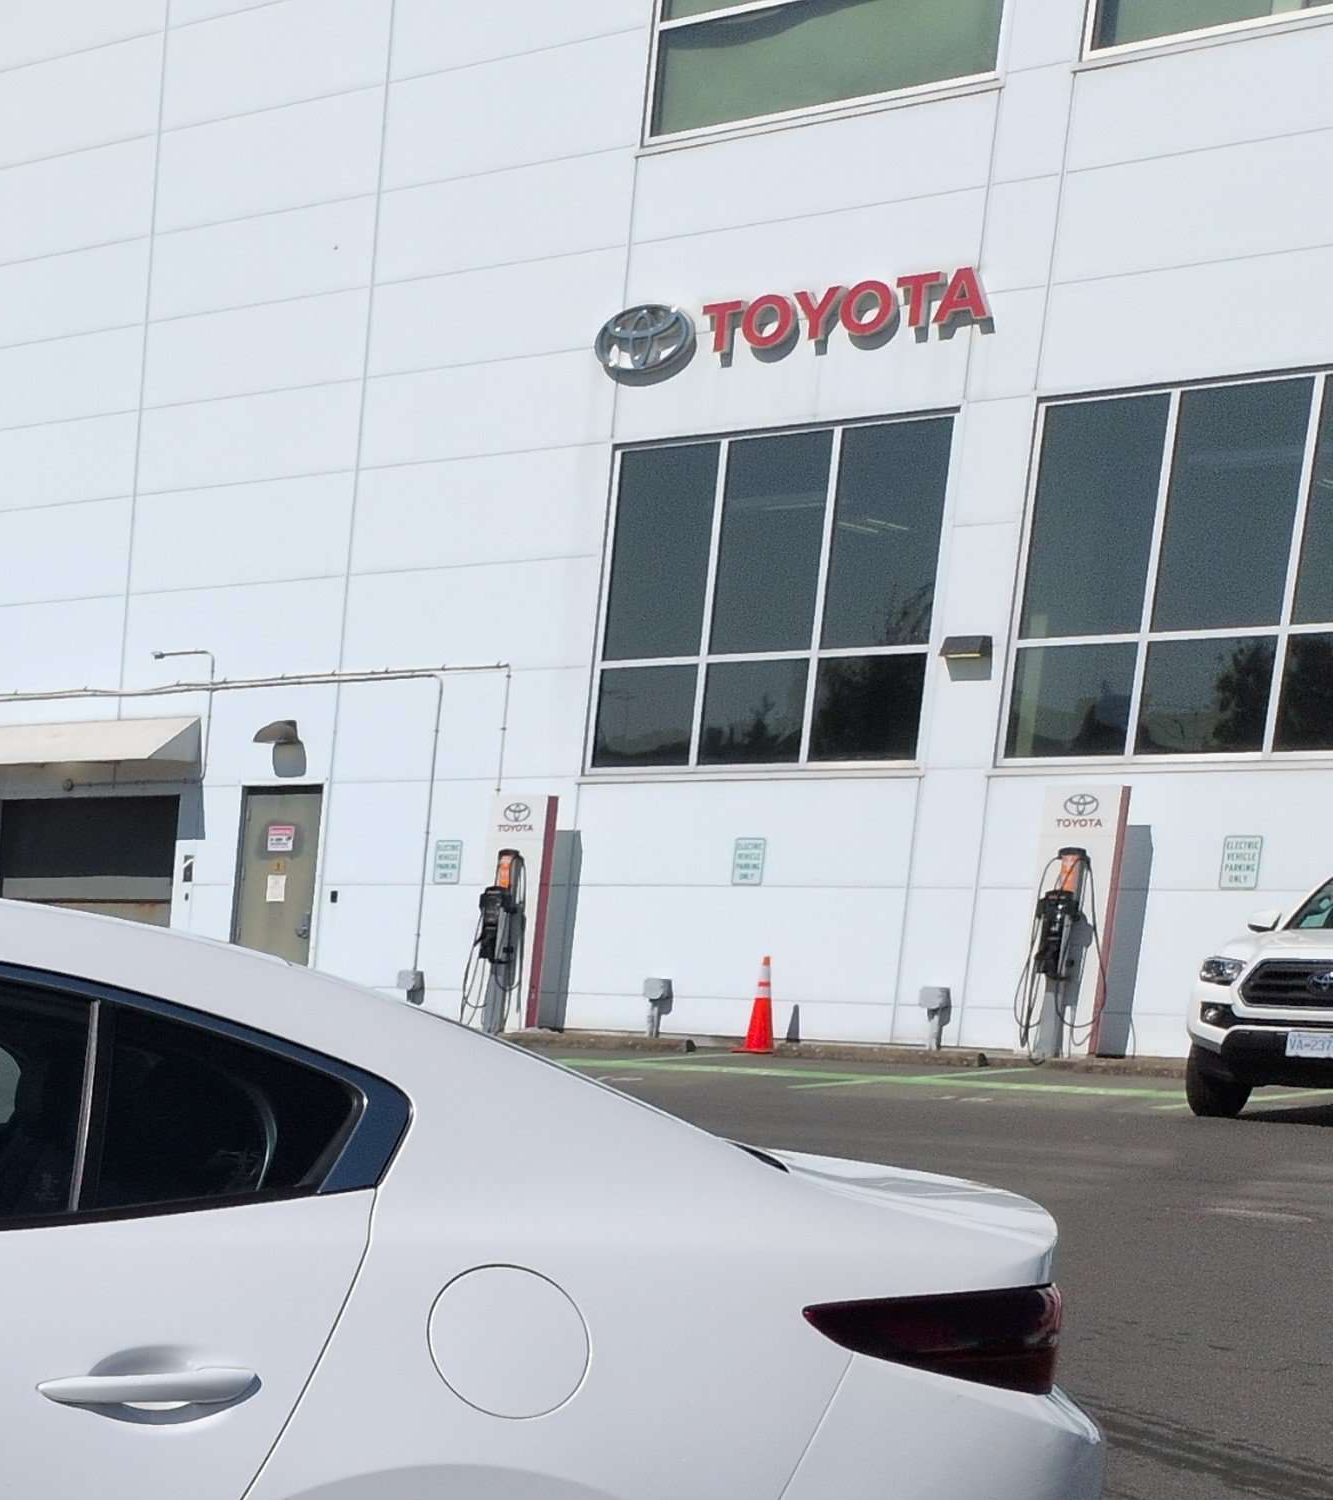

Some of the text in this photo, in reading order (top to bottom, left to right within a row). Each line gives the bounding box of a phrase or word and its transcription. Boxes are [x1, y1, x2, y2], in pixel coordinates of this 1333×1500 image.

[702, 266, 989, 353] TOYOTA
[497, 824, 534, 832] TOYOTA
[1055, 818, 1103, 828] TOYOTA
